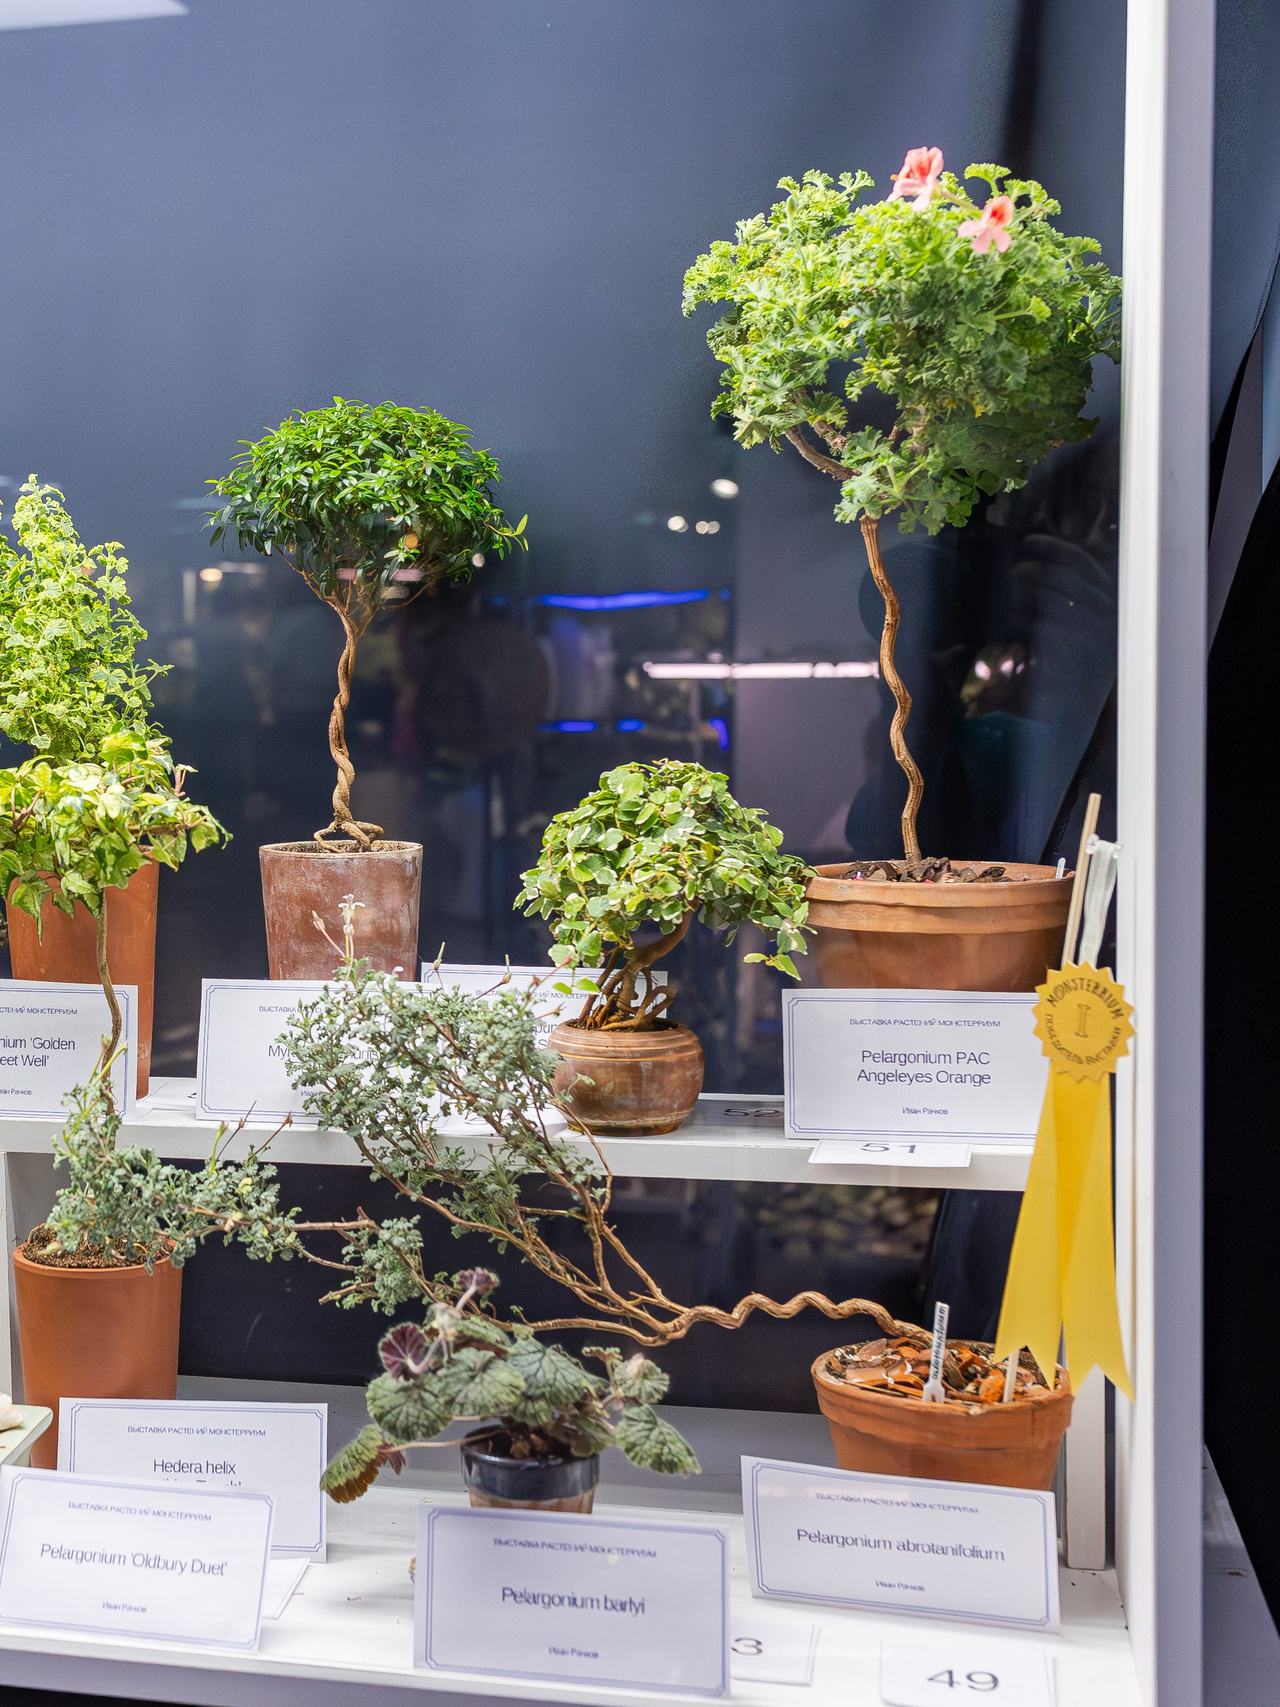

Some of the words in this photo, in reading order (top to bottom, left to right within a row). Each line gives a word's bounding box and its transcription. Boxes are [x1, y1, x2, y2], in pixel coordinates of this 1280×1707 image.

[26, 1007, 78, 1015] МОНСТЕРРИУМ
[849, 1018, 893, 1026] ВЫСТАВКА
[893, 1018, 936, 1026] РАСТЕНИЙ
[937, 1019, 1001, 1027] МОНСТЕРРИУМ
[29, 1037, 76, 1051] ‘Golden
[20, 1054, 50, 1067] Well’
[861, 1050, 952, 1066] Pelargonium
[956, 1051, 991, 1065] PAC
[857, 1069, 933, 1085] Angeleyes
[936, 1070, 991, 1087] Orange
[722, 1107, 784, 1118] 52
[902, 1107, 921, 1115] Иван
[860, 1142, 917, 1153] 51
[127, 1425, 167, 1434] ВЫСТАВКА
[167, 1426, 208, 1435] РАСТЕНИЙ
[208, 1428, 266, 1437] МОНСТЕРРИУМ
[153, 1459, 203, 1474] Hedera
[205, 1460, 236, 1475] helix
[796, 1528, 892, 1550] Pelargonium
[896, 1539, 1005, 1562] abrotanifolium
[40, 1543, 127, 1566] Pelargonium
[501, 1586, 600, 1611] Pelargonium
[731, 1637, 763, 1656] 3
[927, 1669, 1000, 1691] 49
